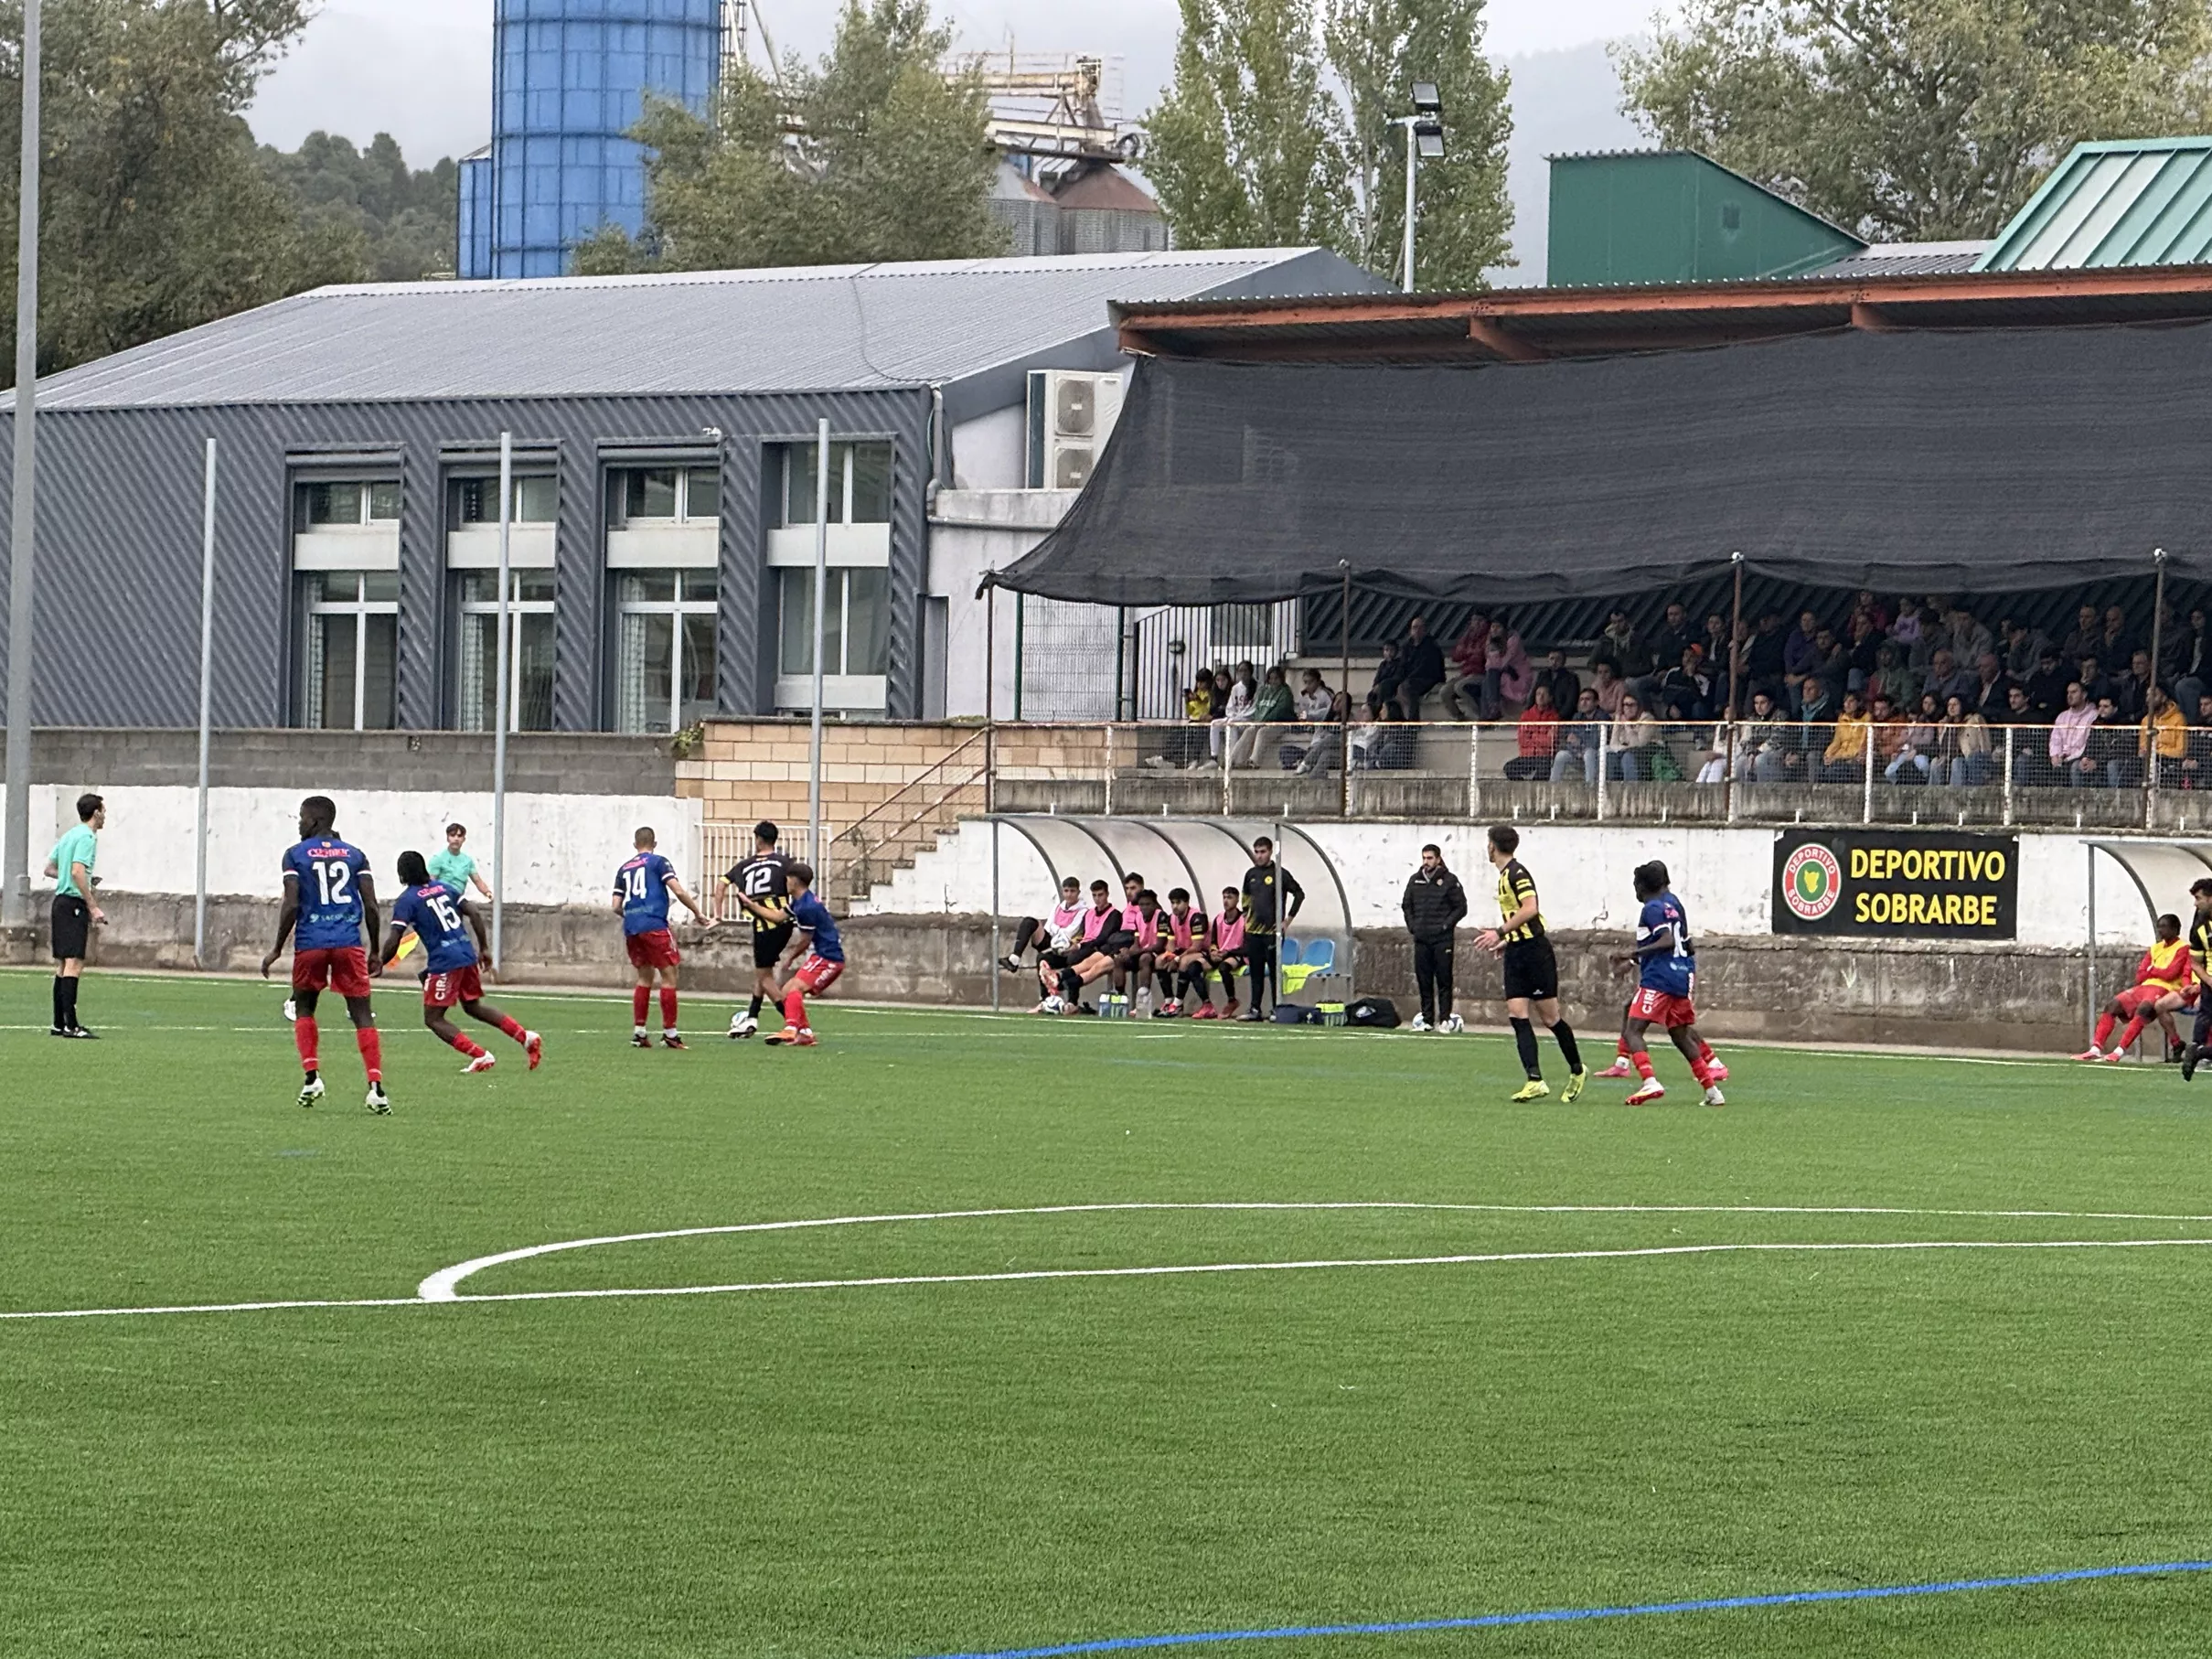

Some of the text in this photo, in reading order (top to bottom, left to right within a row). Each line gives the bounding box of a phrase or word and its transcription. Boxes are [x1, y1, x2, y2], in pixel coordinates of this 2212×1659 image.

[1788, 847, 1836, 874] DEPORTIVO
[1851, 849, 2005, 882] DEPORTIVO
[312, 861, 352, 905] 12
[622, 866, 647, 903] 14
[745, 866, 772, 896] 12
[426, 894, 462, 932] 15
[1788, 888, 1835, 915] SOBRARBE
[1855, 893, 1997, 926] SOBRARBE
